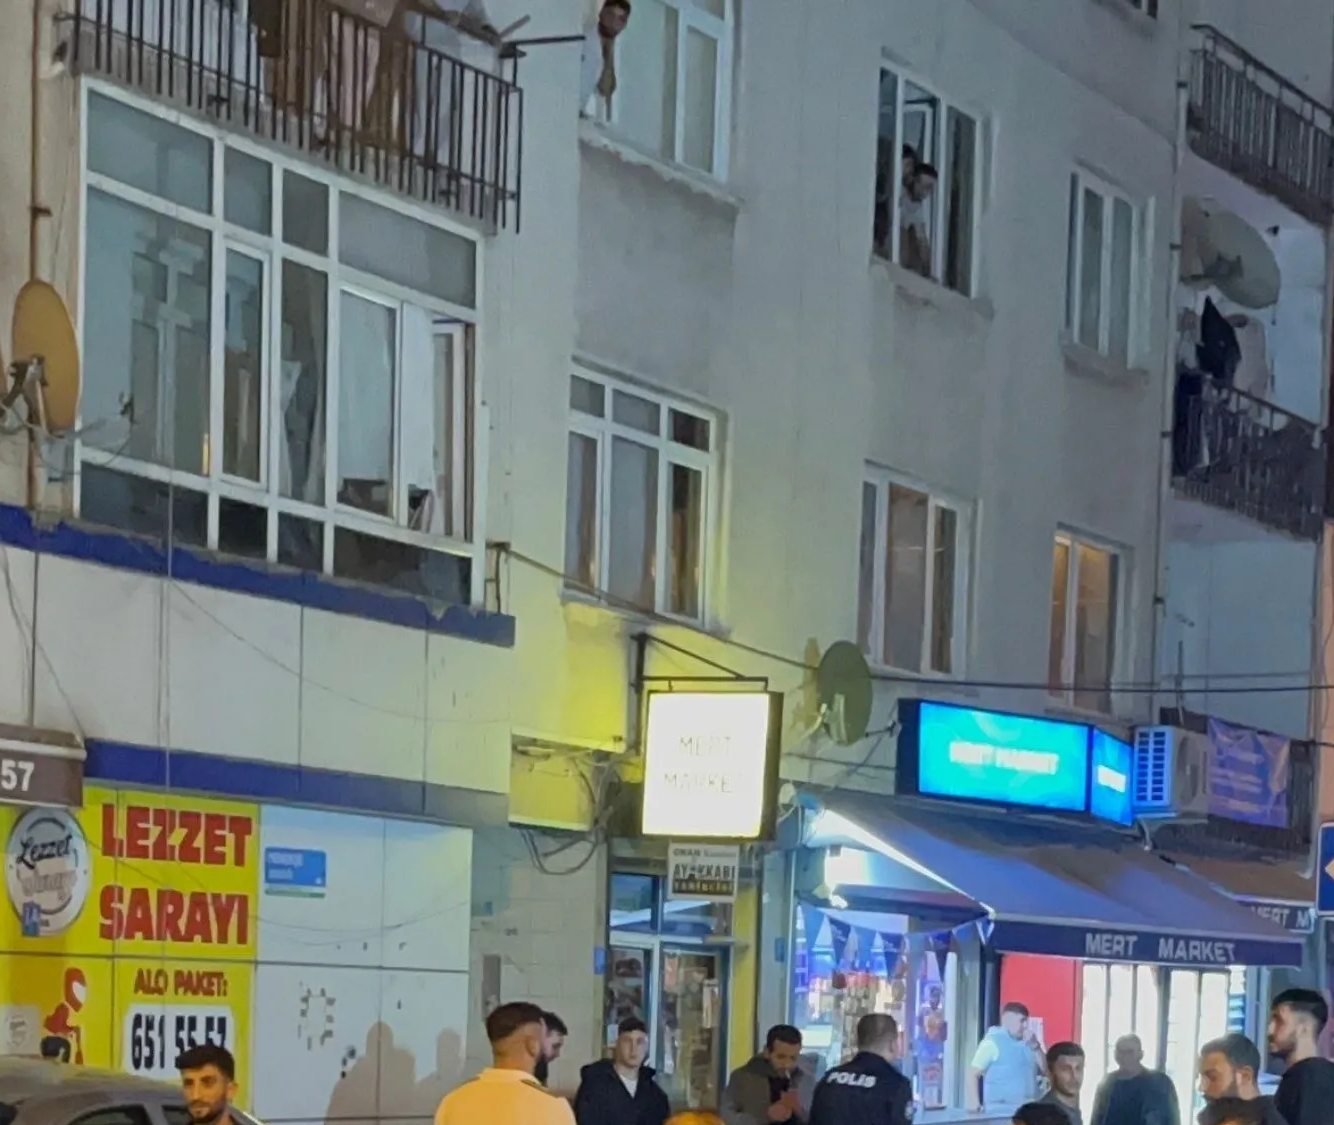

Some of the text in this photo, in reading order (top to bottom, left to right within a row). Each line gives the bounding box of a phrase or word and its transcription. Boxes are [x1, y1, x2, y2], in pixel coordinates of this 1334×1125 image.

[1, 760, 36, 792] 57
[100, 803, 253, 868] LEZZET
[99, 885, 249, 945] SARAYI
[1252, 906, 1291, 927] ERT
[1085, 932, 1237, 963] MERT MARKET
[131, 1013, 166, 1070] 651
